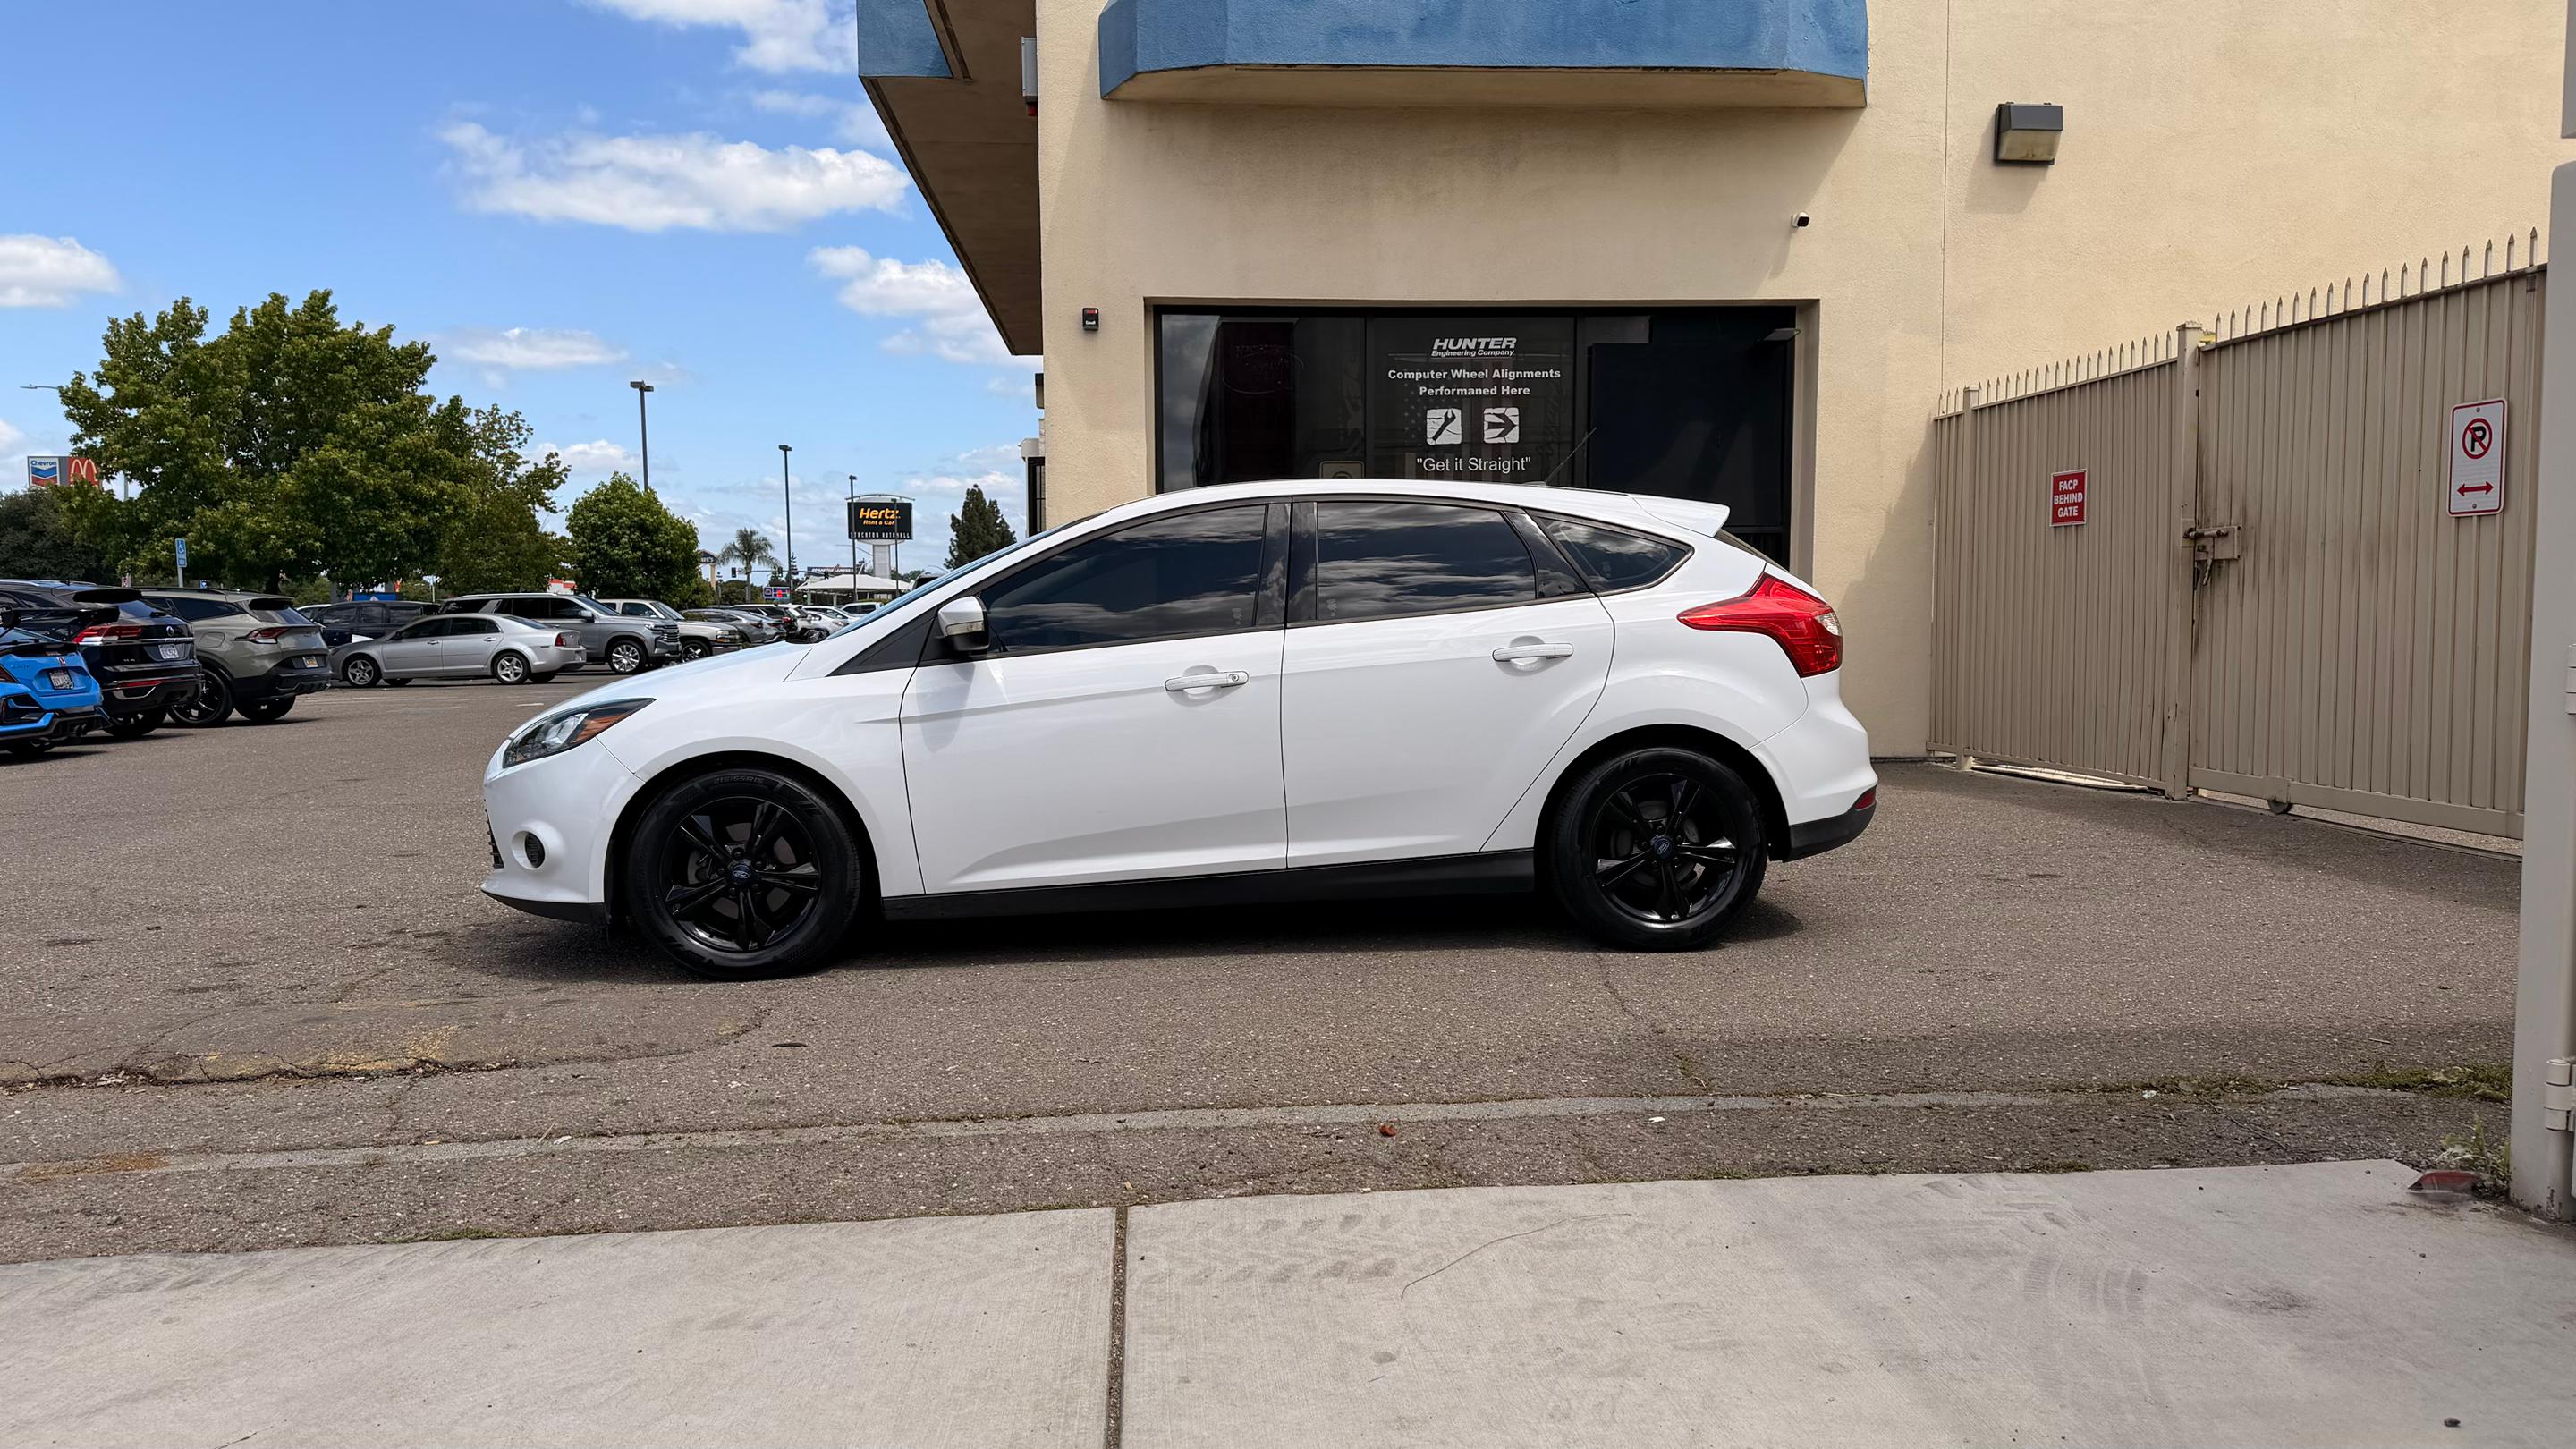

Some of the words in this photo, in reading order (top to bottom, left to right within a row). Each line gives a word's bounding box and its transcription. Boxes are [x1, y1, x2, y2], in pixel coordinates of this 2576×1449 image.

[1432, 337, 1517, 350] HUNTER
[1431, 350, 1476, 358] Engineering
[1477, 349, 1514, 357] Company
[1387, 369, 1448, 381] Computer
[1450, 369, 1489, 379] Wheel
[1492, 369, 1562, 380] Alignments
[1419, 386, 1497, 396] Performaned
[1501, 386, 1531, 395] Here
[1416, 458, 1451, 471] "Get
[1454, 458, 1463, 471] it
[1468, 457, 1531, 474] Straight"
[2058, 479, 2079, 491] FACP
[2054, 492, 2083, 505] BEHIND
[859, 507, 900, 519] Hertz
[2057, 505, 2079, 518] GATE
